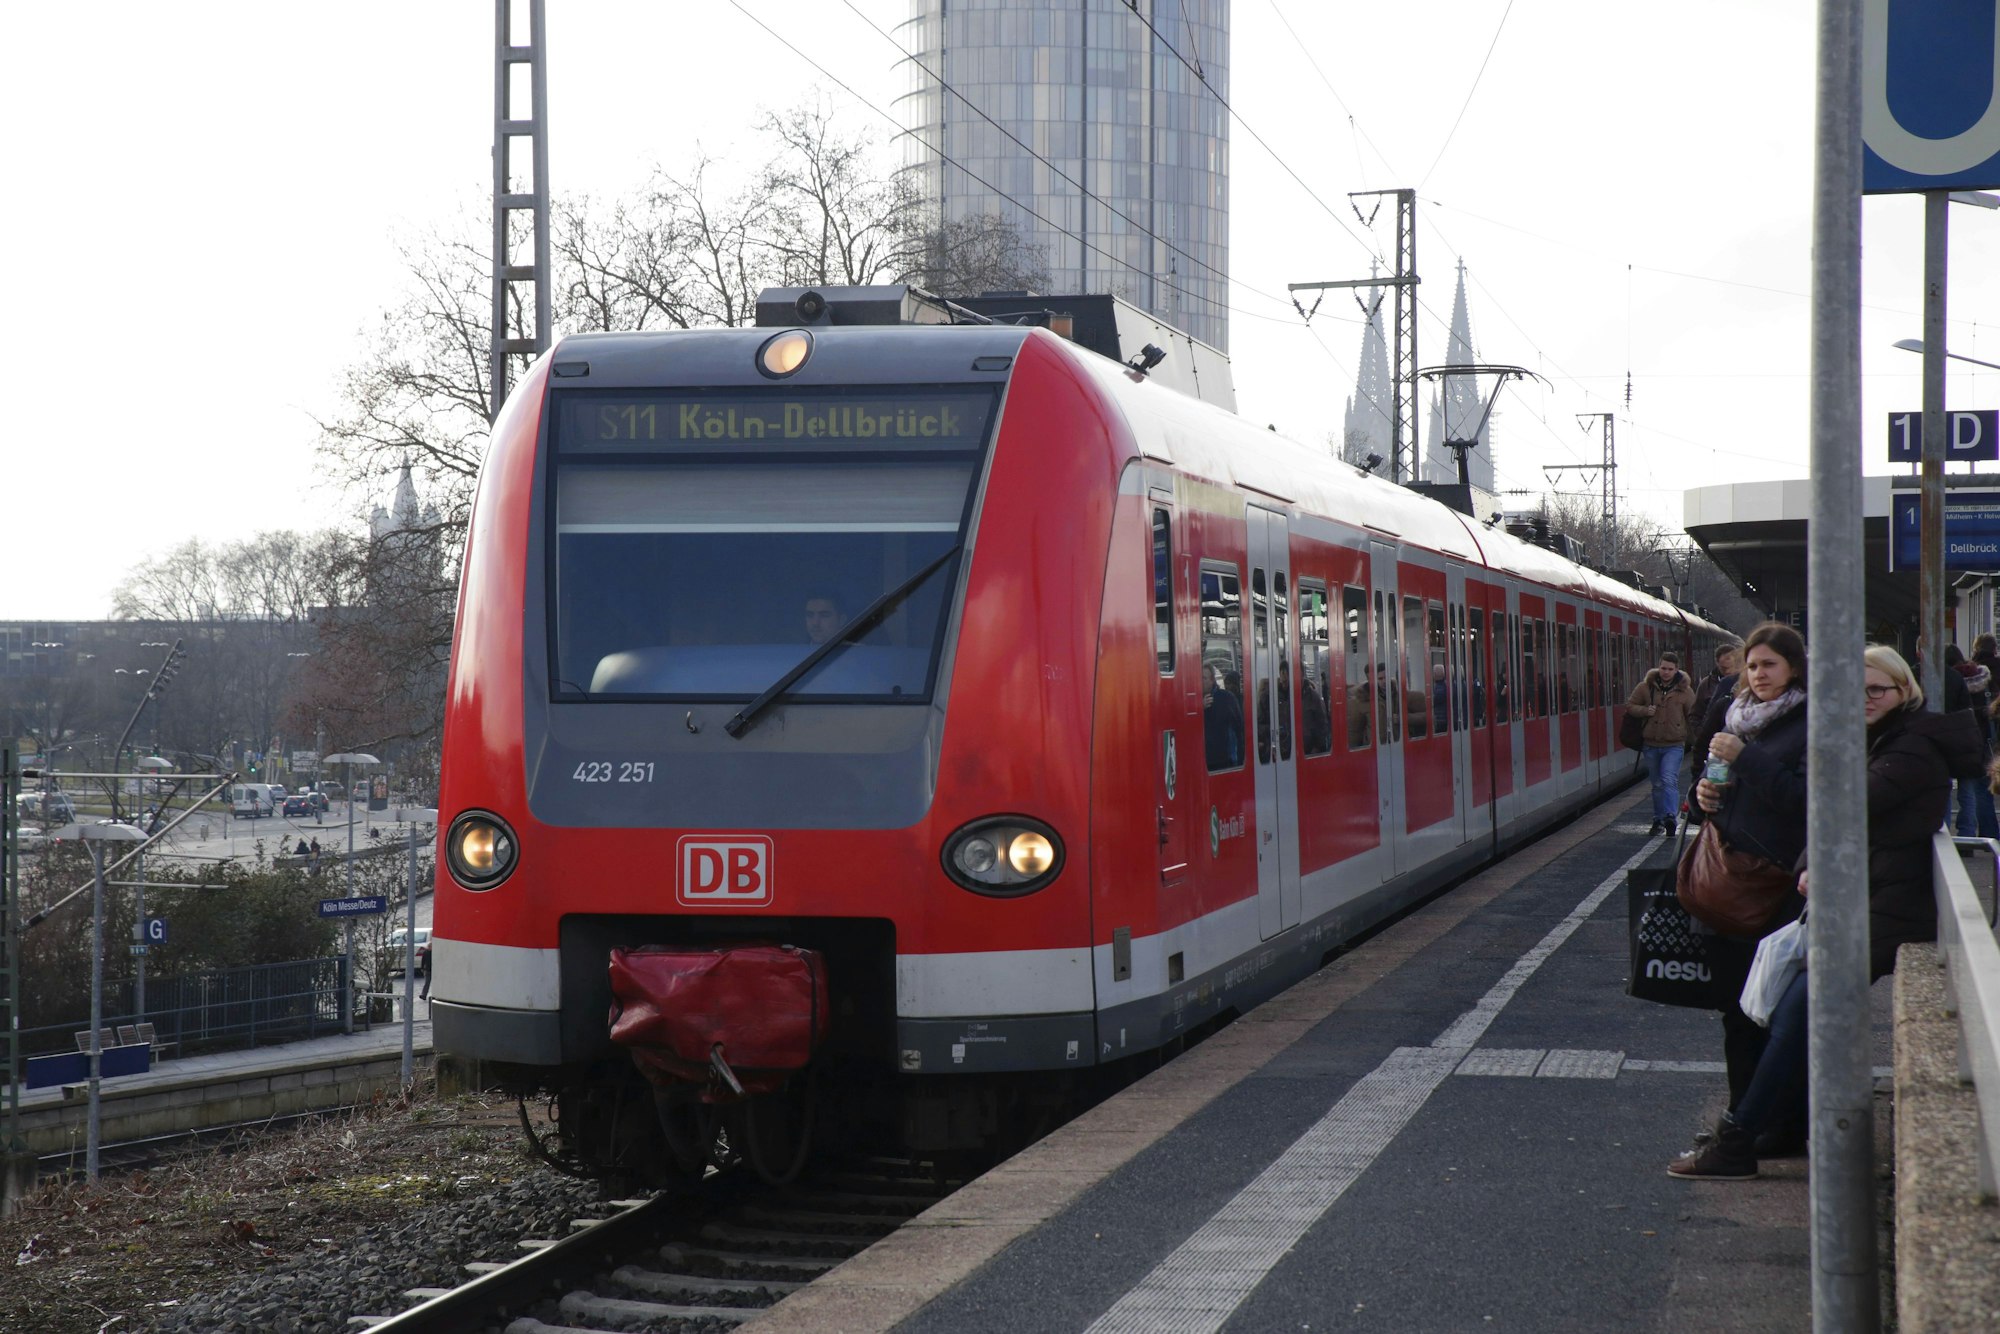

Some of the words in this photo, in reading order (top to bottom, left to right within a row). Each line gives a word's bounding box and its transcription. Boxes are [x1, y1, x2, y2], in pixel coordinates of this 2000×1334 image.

[600, 404, 656, 440] S11
[679, 403, 960, 439] Köln-Dellbrück
[1894, 414, 1911, 450] 1
[1952, 412, 1982, 450] D
[1906, 507, 1915, 525] 1
[1950, 543, 1998, 553] Dellbrück
[1790, 612, 1801, 626] E
[573, 762, 613, 782] 423
[618, 762, 655, 782] 251
[690, 847, 761, 894] DB
[323, 901, 338, 912] Köln
[338, 899, 377, 911] Messe/Deutz
[149, 919, 163, 939] G
